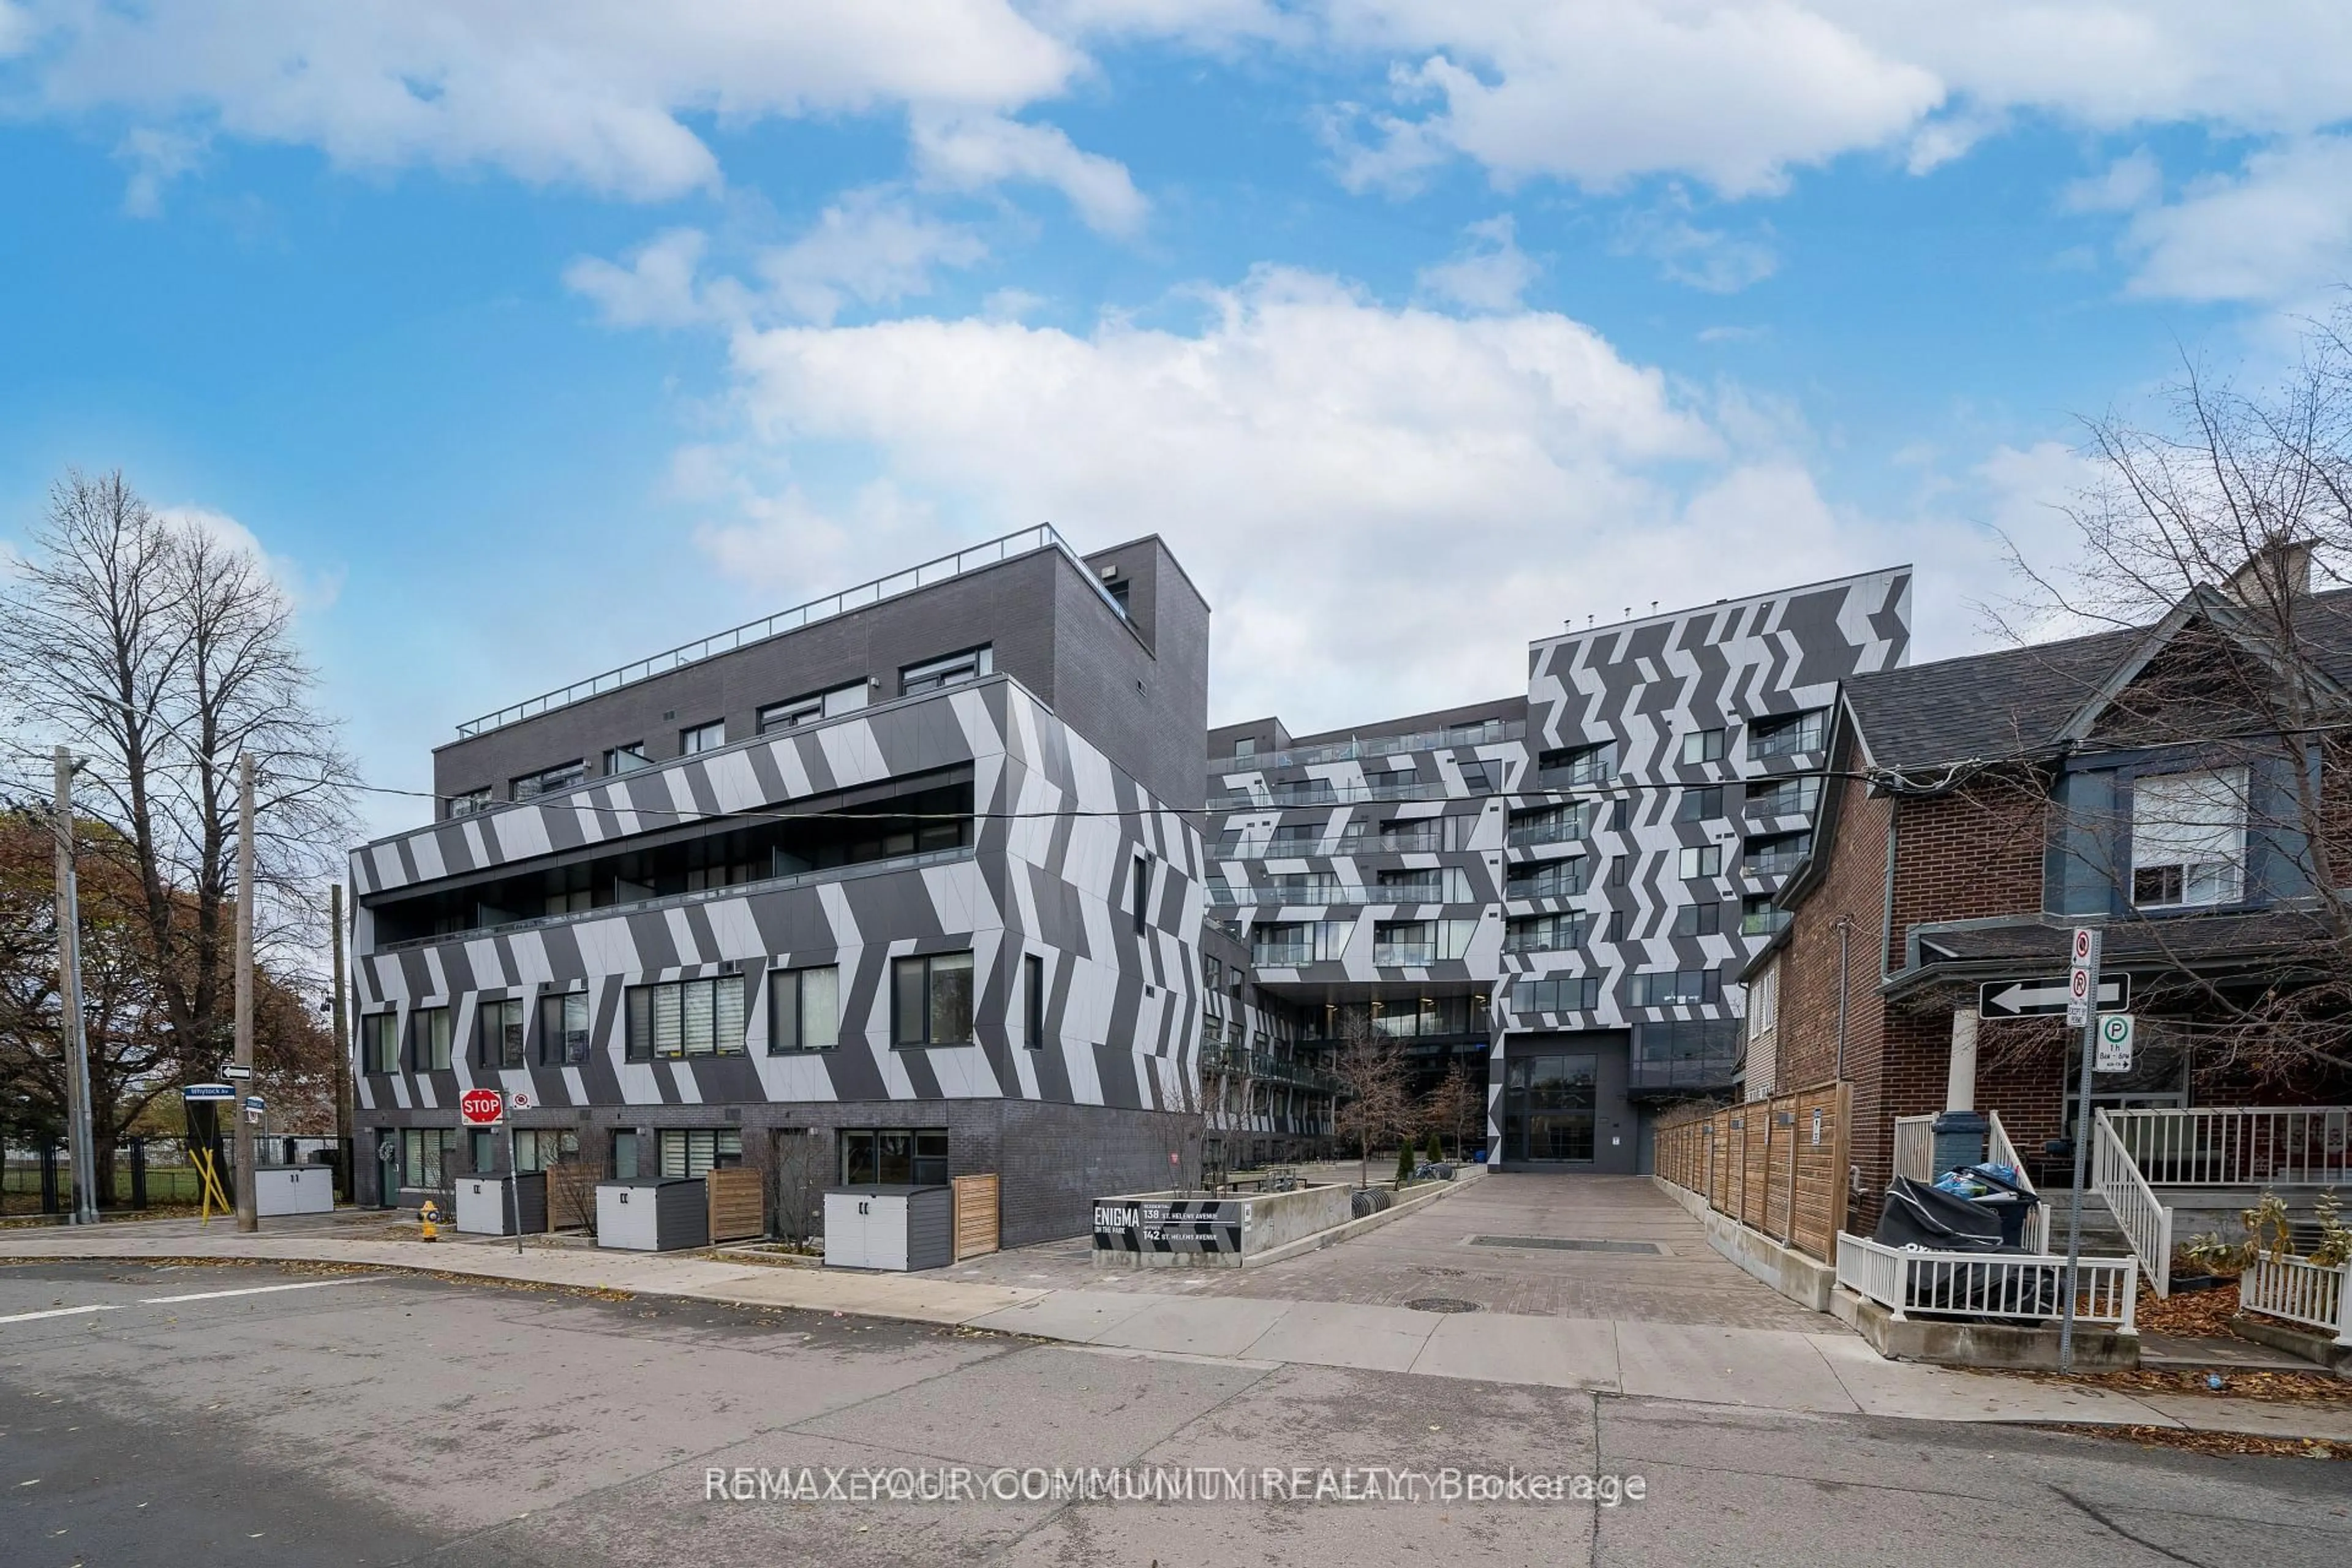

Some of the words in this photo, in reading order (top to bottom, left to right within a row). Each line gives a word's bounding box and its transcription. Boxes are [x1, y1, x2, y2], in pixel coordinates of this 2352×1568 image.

[464, 1099, 499, 1114] STOP
[1094, 1207, 1140, 1227] ENIGMA
[1143, 1210, 1159, 1219] 138
[1142, 1231, 1160, 1240] 142
